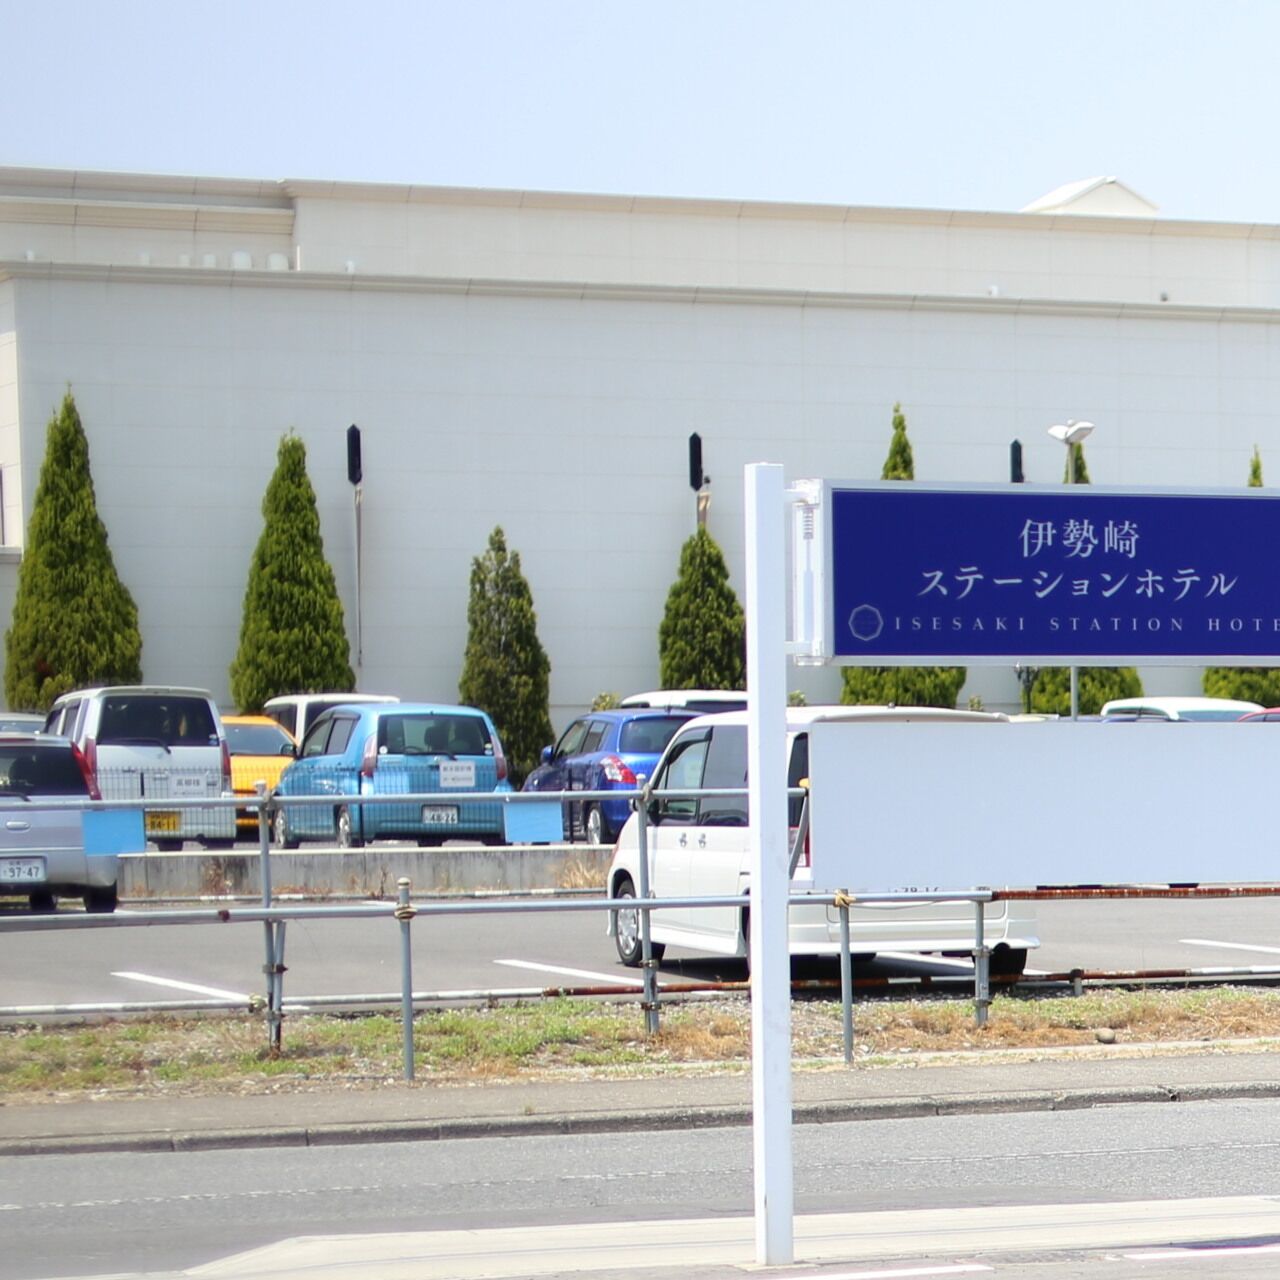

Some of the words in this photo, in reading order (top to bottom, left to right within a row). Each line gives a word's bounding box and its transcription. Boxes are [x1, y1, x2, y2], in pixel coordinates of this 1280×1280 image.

[1018, 517, 1141, 559] 伊勢崎
[917, 566, 1240, 600] ステーションホテル
[895, 617, 1026, 632] ISESAKI
[1049, 617, 1185, 632] STATION
[9, 866, 40, 879] 97-47
